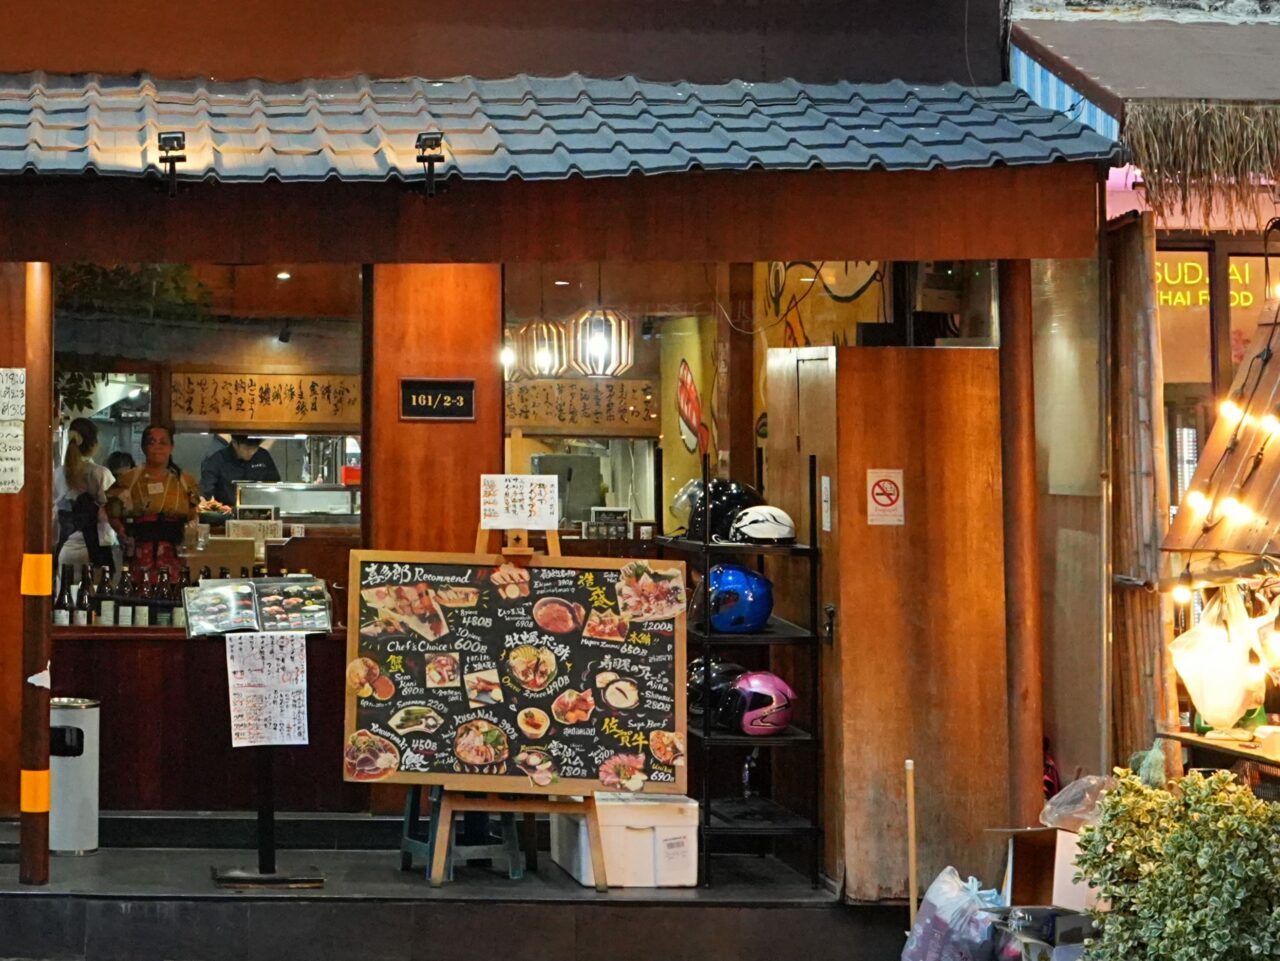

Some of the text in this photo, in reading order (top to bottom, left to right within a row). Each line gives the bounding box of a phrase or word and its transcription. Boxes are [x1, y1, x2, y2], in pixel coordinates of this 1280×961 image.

[1154, 262, 1250, 285] SUDAI
[1157, 291, 1254, 307] HAI FOD
[410, 393, 465, 409] 161/2-3
[414, 568, 472, 584] Recommend
